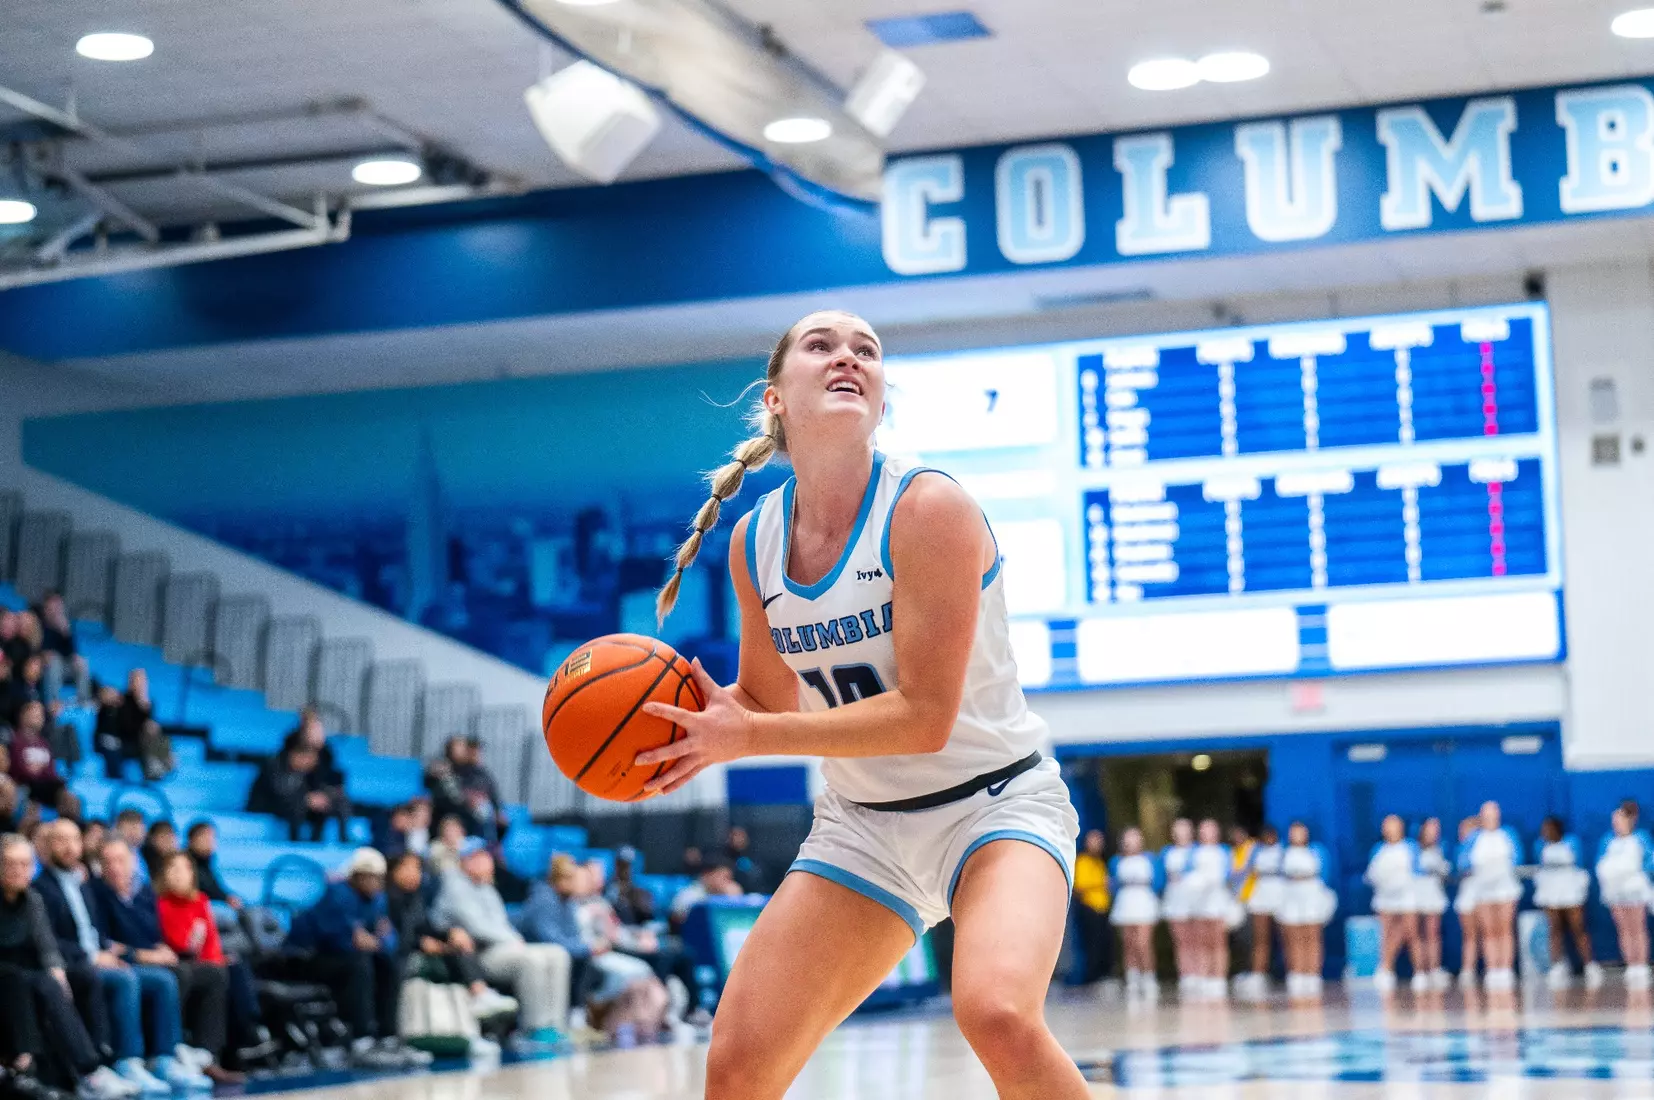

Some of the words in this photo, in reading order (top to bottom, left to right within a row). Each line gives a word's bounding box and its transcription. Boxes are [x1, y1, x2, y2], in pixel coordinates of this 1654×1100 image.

[881, 84, 1654, 275] COLUMB
[856, 570, 873, 581] Ivy
[768, 600, 892, 654] OLUMBI
